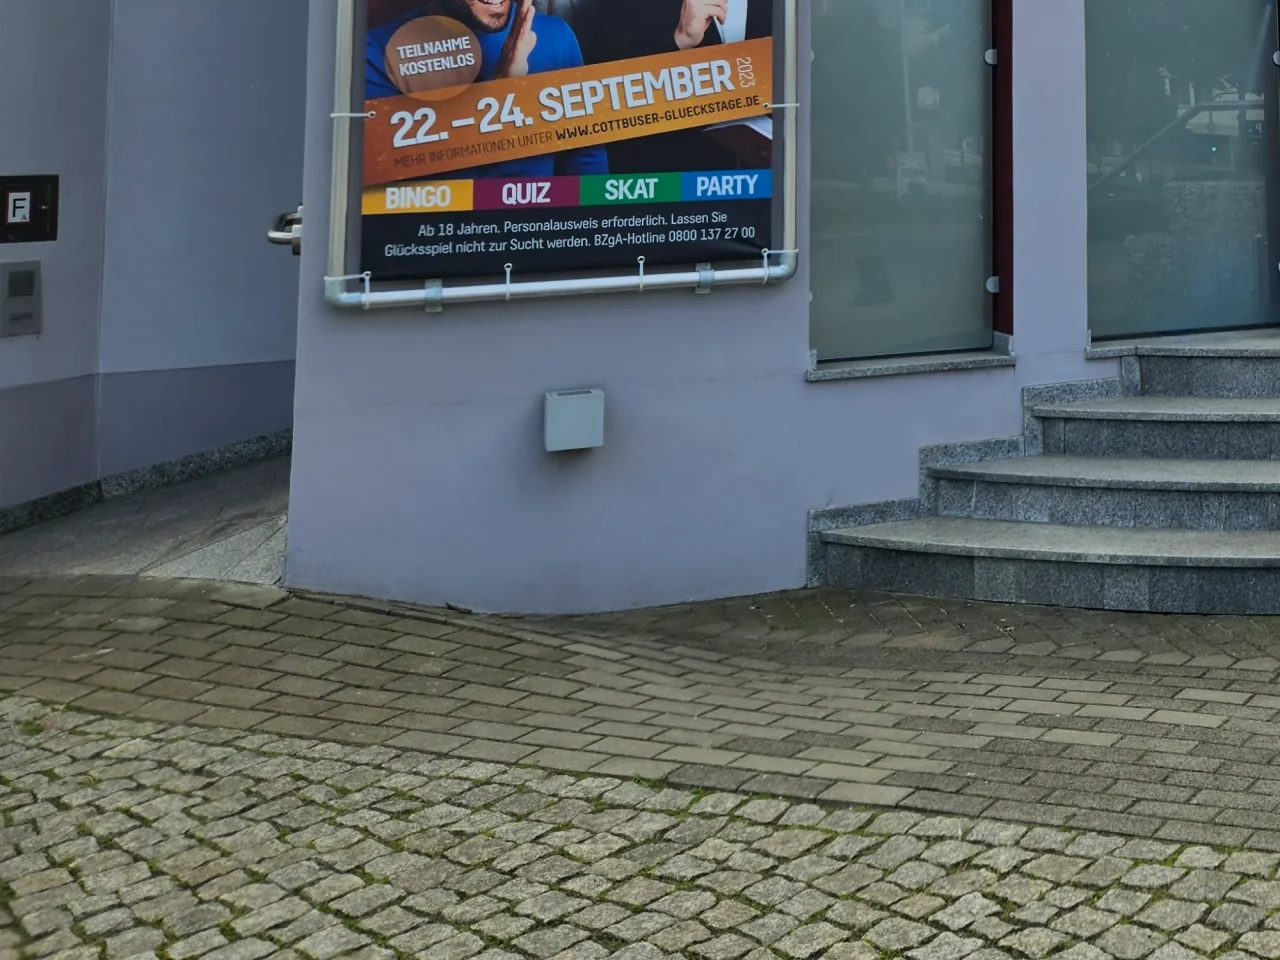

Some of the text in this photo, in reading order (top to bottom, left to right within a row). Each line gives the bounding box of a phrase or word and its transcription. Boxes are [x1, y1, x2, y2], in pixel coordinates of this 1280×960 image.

[396, 36, 472, 60] TEILNAHME
[399, 52, 476, 77] KOSTENLOS
[736, 56, 756, 89] 2023
[538, 59, 737, 123] SEPTEMBER
[394, 95, 761, 169] MEHR INFORMATIONEN UNTER WWW.COTTBUSER-GLUECKSTAGE.DE
[384, 174, 759, 210] BINGO QUIZ SKAT PARTY
[12, 198, 27, 218] F
[417, 211, 728, 237] Ab 18 Jahren. Personalausweis erforderlich. Lassen Sie
[384, 226, 756, 257] Glücksspiel nicht zur Sucht werden. BZgA-Hotline 0800 137 27 00
